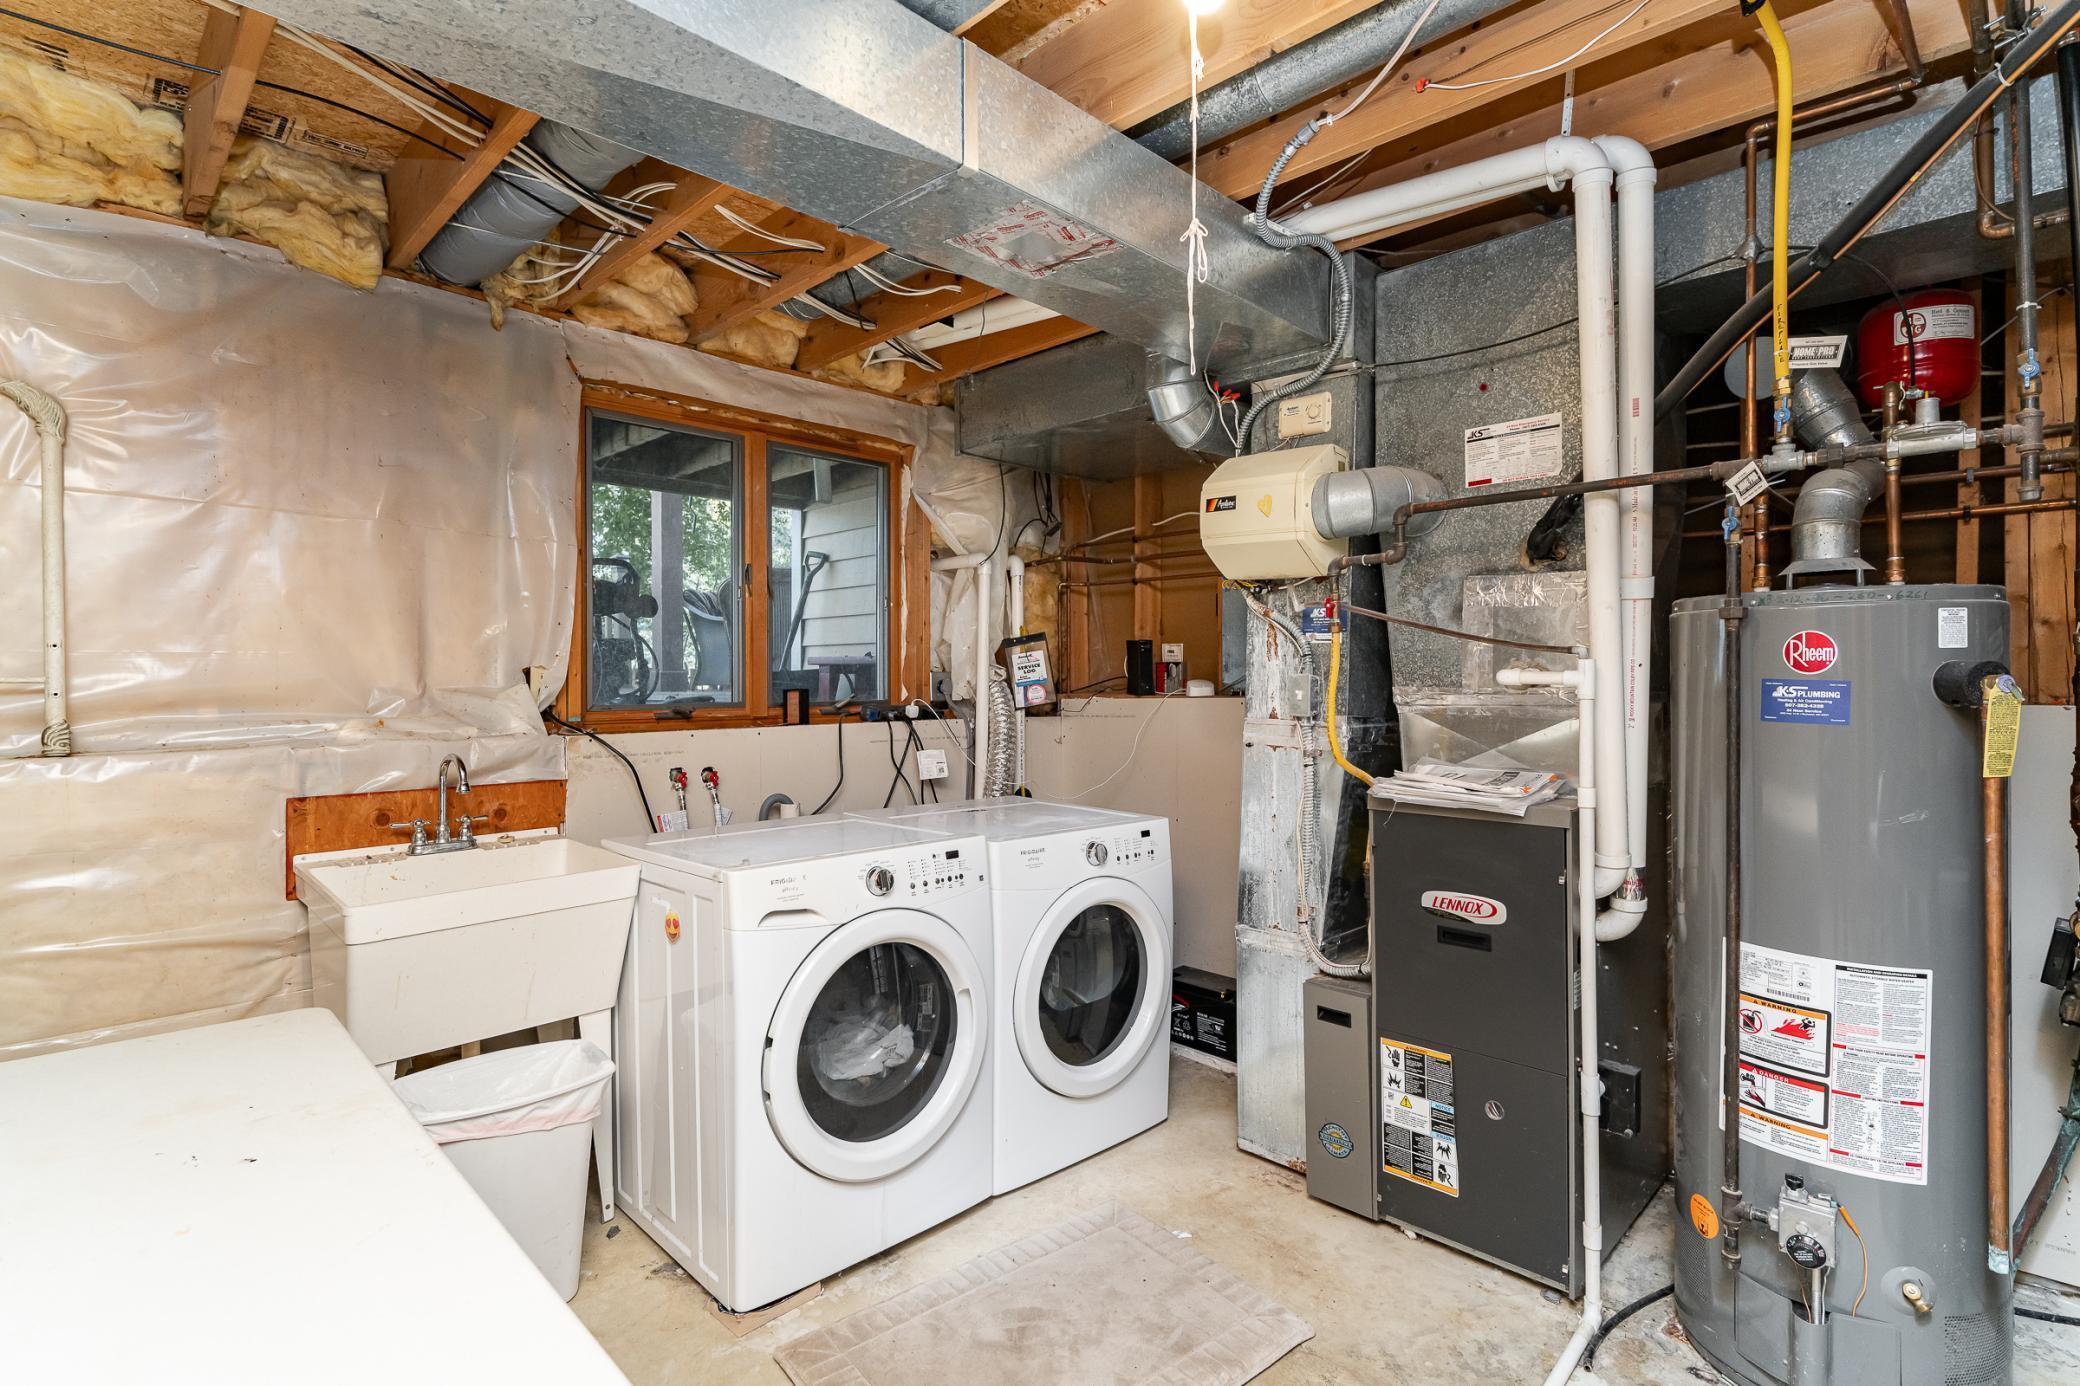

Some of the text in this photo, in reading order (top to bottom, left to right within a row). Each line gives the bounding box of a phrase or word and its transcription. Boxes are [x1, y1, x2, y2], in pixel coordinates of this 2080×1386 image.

[1789, 632, 1834, 668] Rheem
[1017, 662, 1041, 671] SERVICE
[1798, 690, 1840, 698] PLUMBING
[1432, 896, 1484, 915] LENNOX
[1760, 1001, 1797, 1014] WARNING
[1759, 1070, 1790, 1084] DANGER
[1758, 1115, 1791, 1130] WARNING
